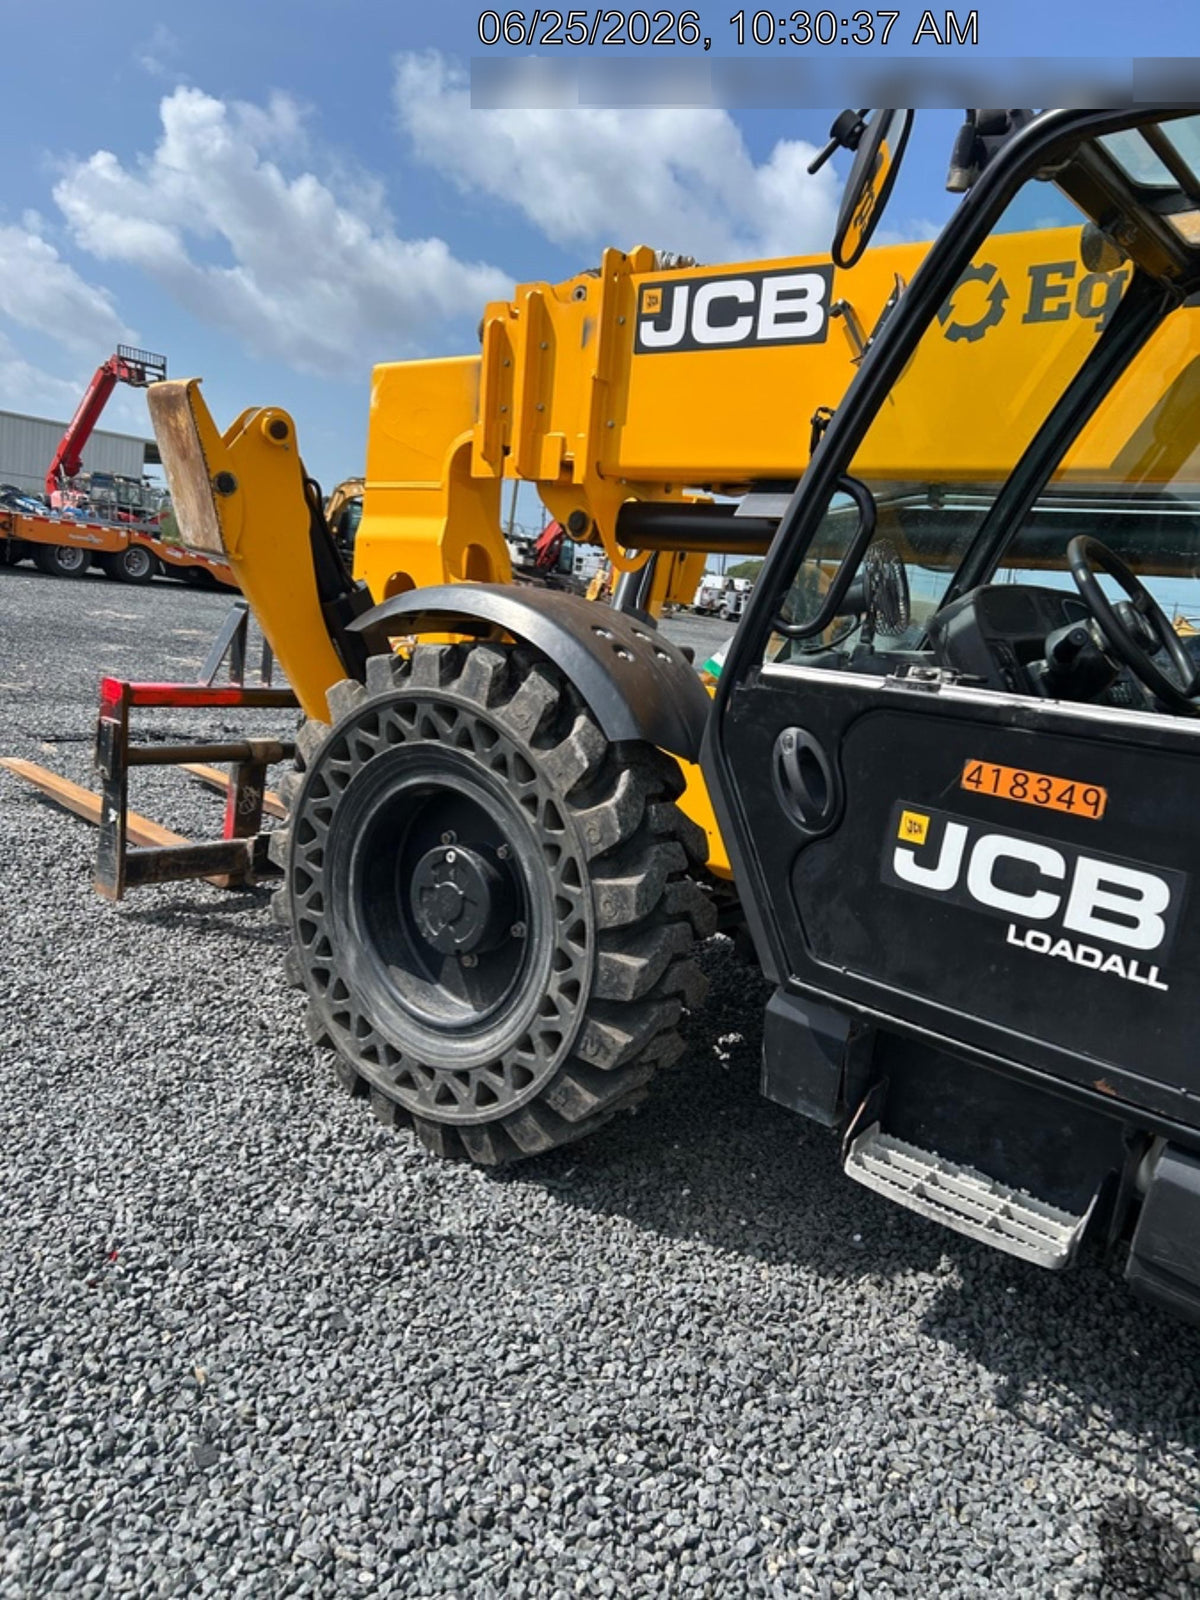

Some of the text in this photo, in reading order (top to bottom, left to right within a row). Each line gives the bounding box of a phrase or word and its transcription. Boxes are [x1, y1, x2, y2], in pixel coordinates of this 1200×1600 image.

[639, 273, 826, 347] JCB
[966, 764, 1101, 816] 418349
[893, 821, 1171, 950] JCB
[1006, 924, 1169, 991] LOADALL
